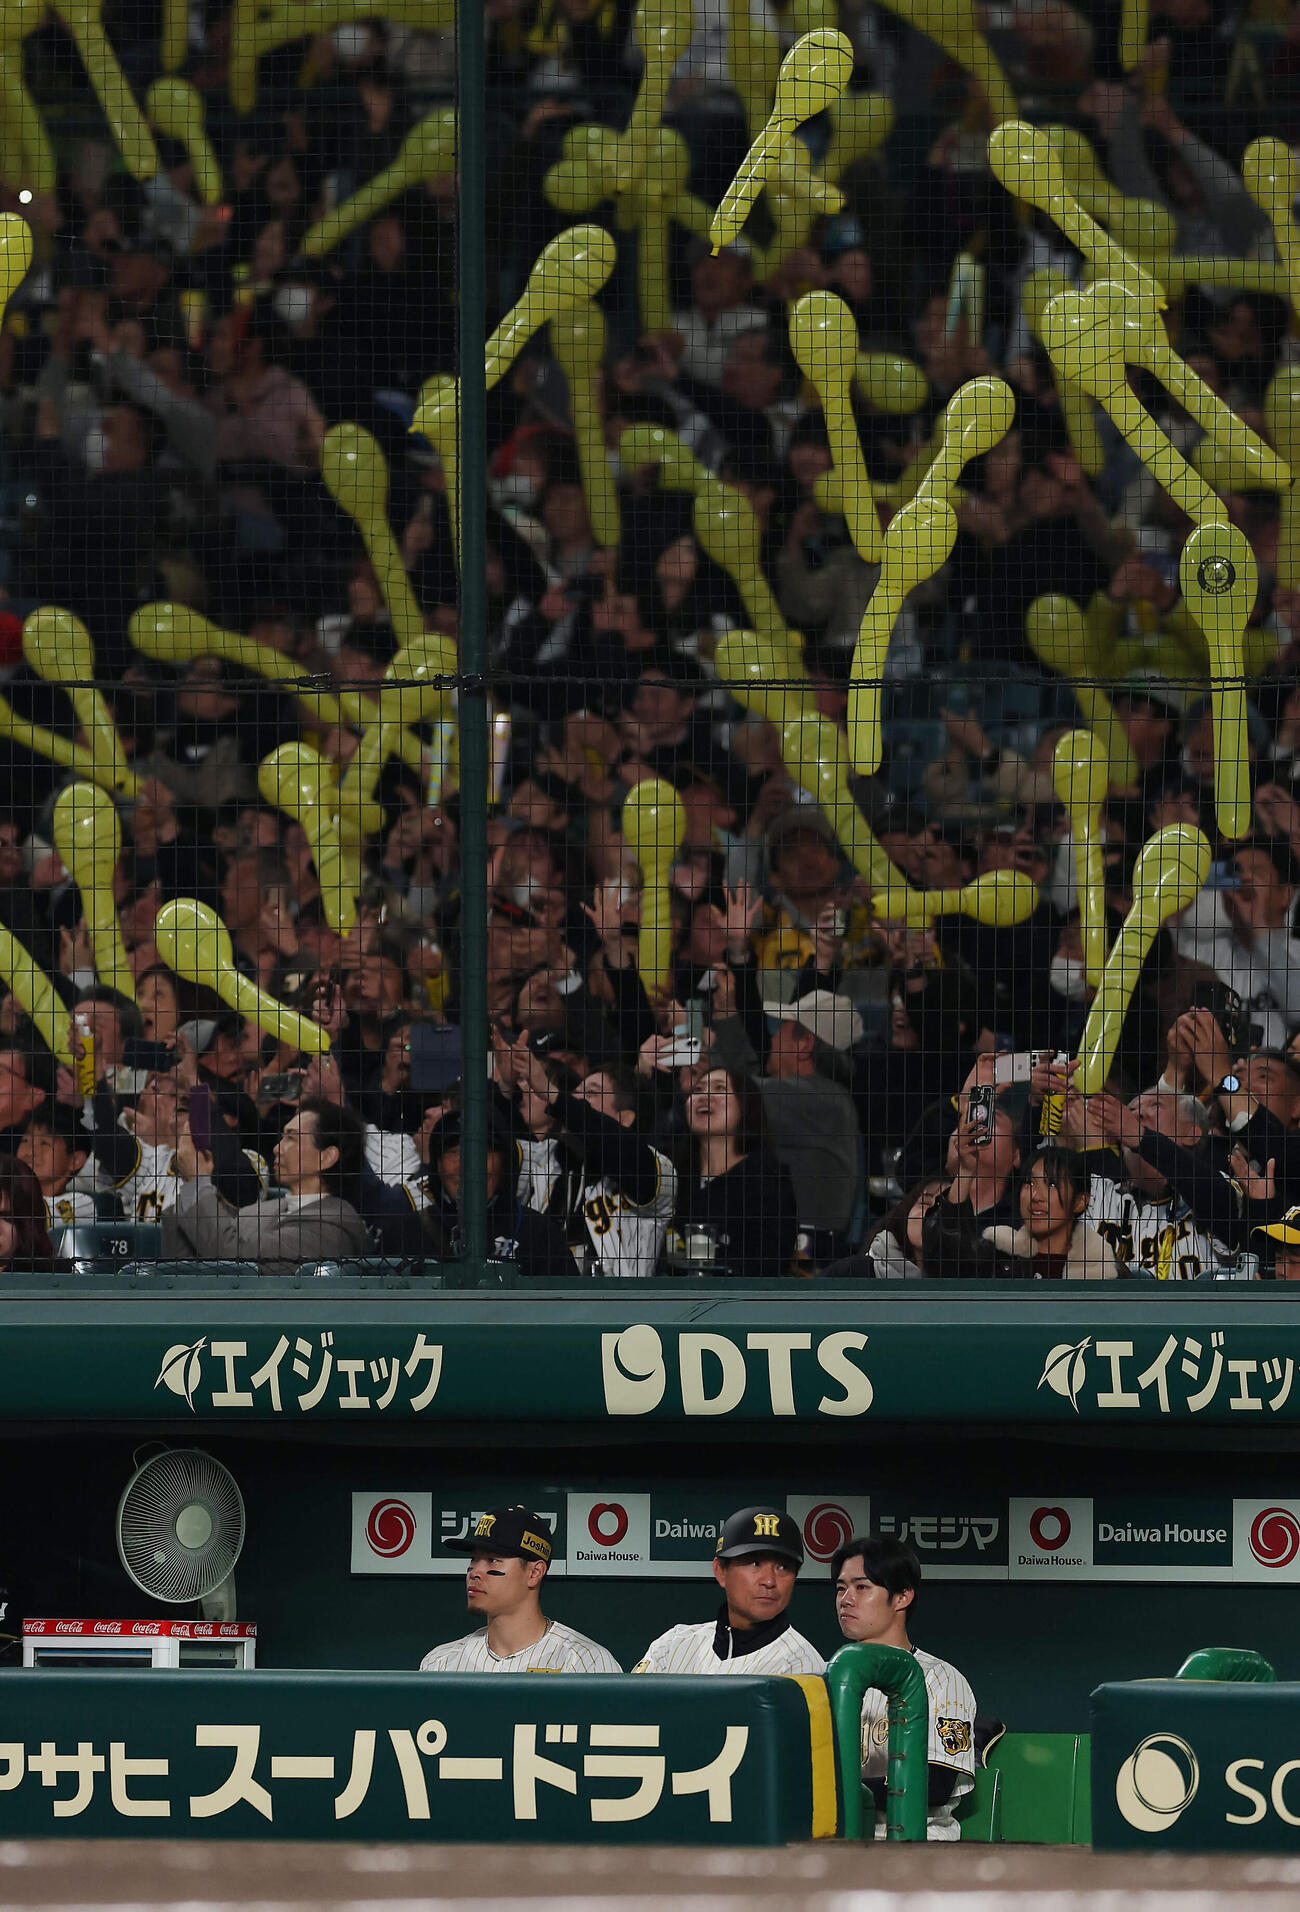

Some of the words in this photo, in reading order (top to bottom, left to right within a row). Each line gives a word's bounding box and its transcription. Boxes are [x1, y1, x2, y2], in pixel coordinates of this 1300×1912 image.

[110, 1240, 128, 1255] 78
[210, 1331, 443, 1412] エイジェック
[678, 1331, 874, 1417] DTS
[655, 1519, 717, 1538] Daiwa
[879, 1516, 999, 1550] シモジマ
[1098, 1522, 1161, 1542] Daiwa
[1164, 1523, 1228, 1543] House
[576, 1550, 608, 1561] Daiwa
[608, 1551, 640, 1561] House
[1018, 1555, 1050, 1566] Daiwa
[1050, 1556, 1083, 1566] House
